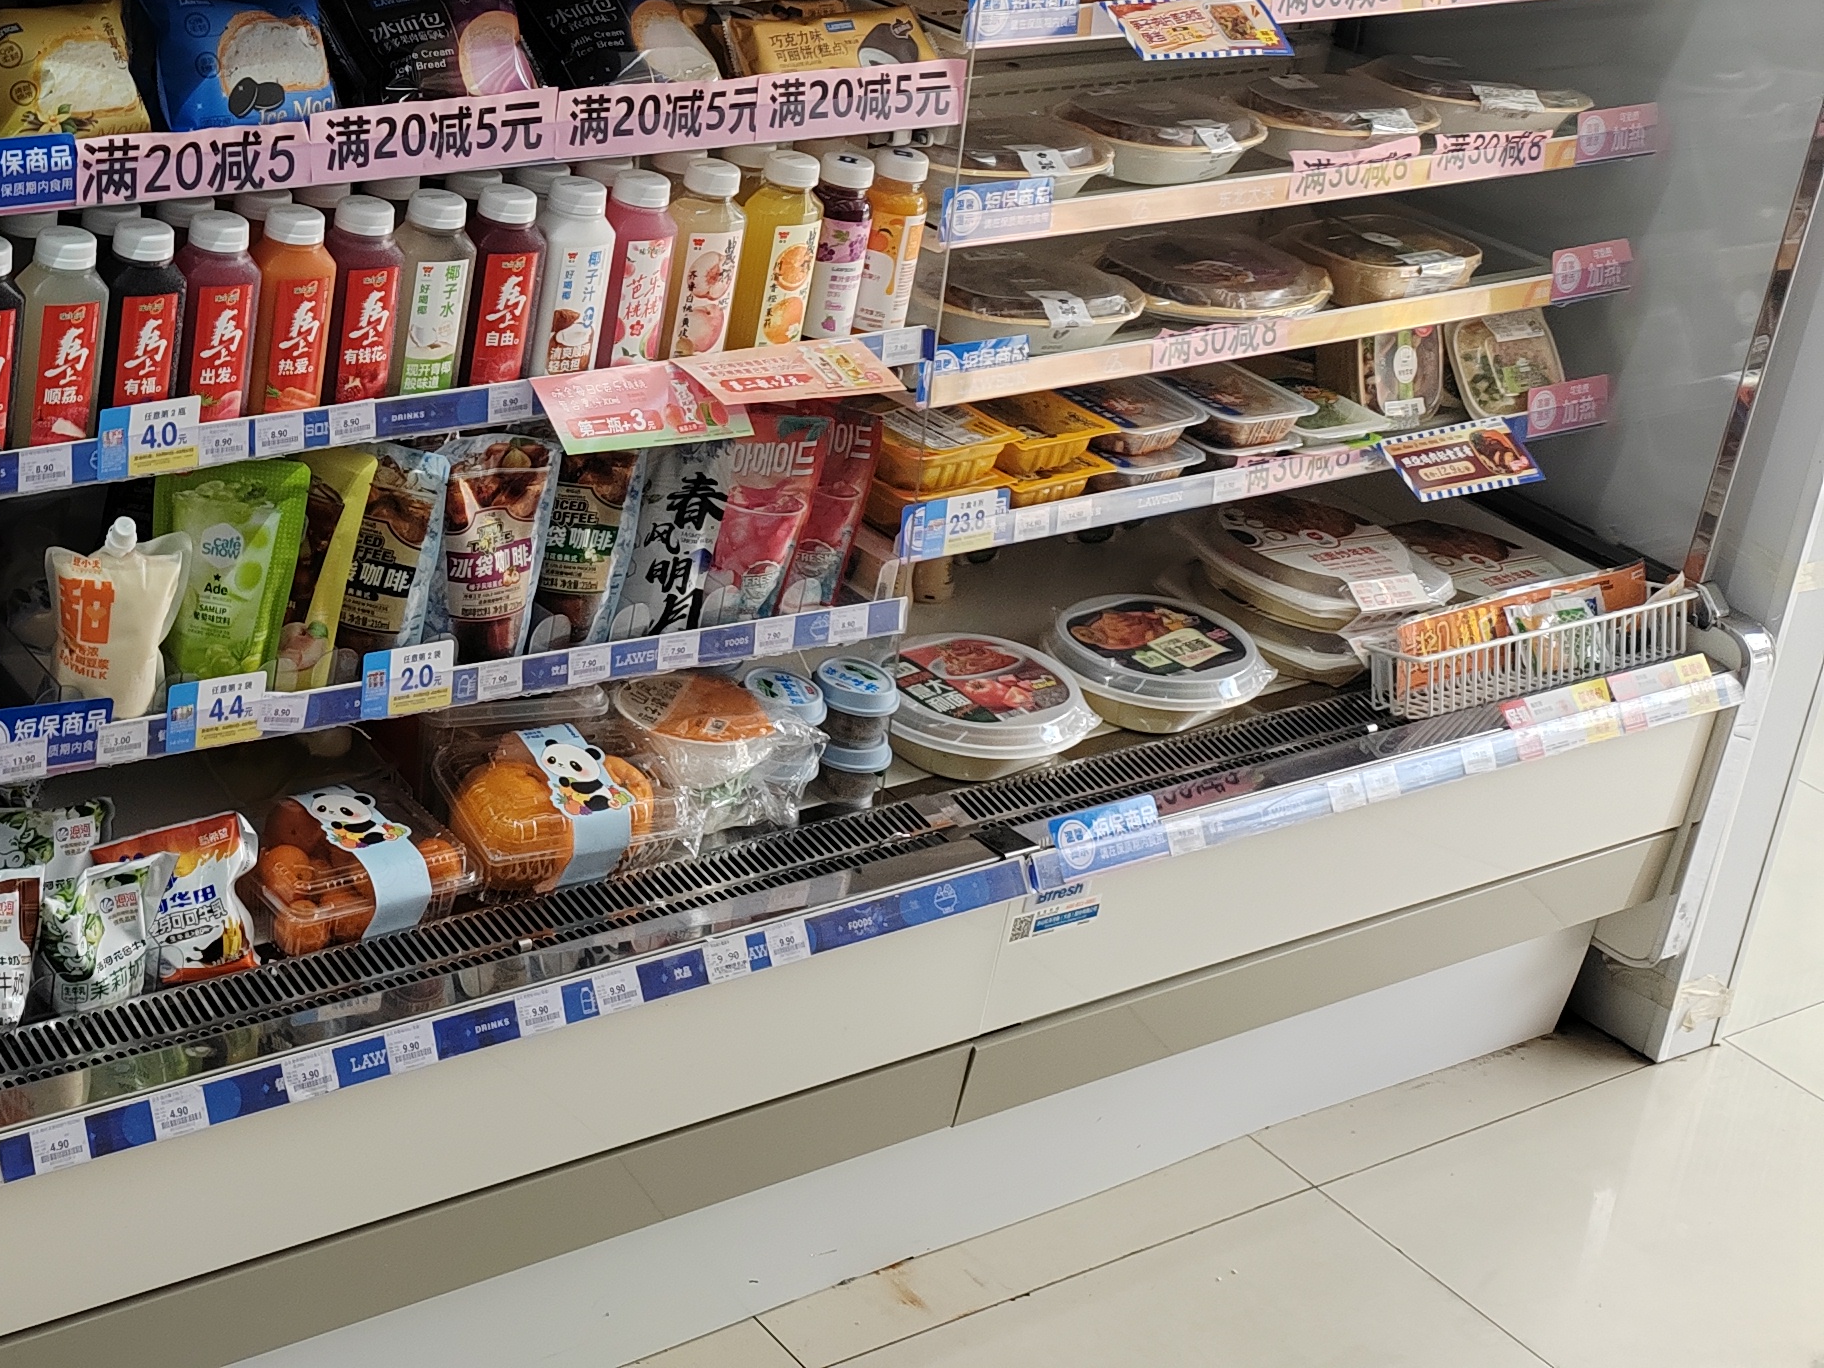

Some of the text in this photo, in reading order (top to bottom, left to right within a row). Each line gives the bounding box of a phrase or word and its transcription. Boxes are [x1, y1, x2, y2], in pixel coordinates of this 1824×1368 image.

[416, 60, 446, 70] Bread
[421, 47, 454, 59] Cream
[769, 69, 953, 129] 满20减5元
[569, 80, 760, 146] 满20减5元
[326, 99, 543, 173] 满20减5元
[1435, 133, 1544, 173] 满30减8
[82, 133, 296, 204] 满20减5
[1157, 325, 1279, 369] 满30减8
[391, 411, 425, 423] DRINKS
[668, 472, 729, 531] 春
[448, 539, 533, 581] 冰袋咖啡
[204, 580, 229, 596] Ade
[199, 602, 226, 614] SAMLIP
[14, 707, 107, 740] 短保商品
[13, 754, 36, 765] 13.90
[847, 915, 876, 932] FOODS
[475, 1016, 512, 1034] DRINKS
[401, 1039, 423, 1054] 9.90
